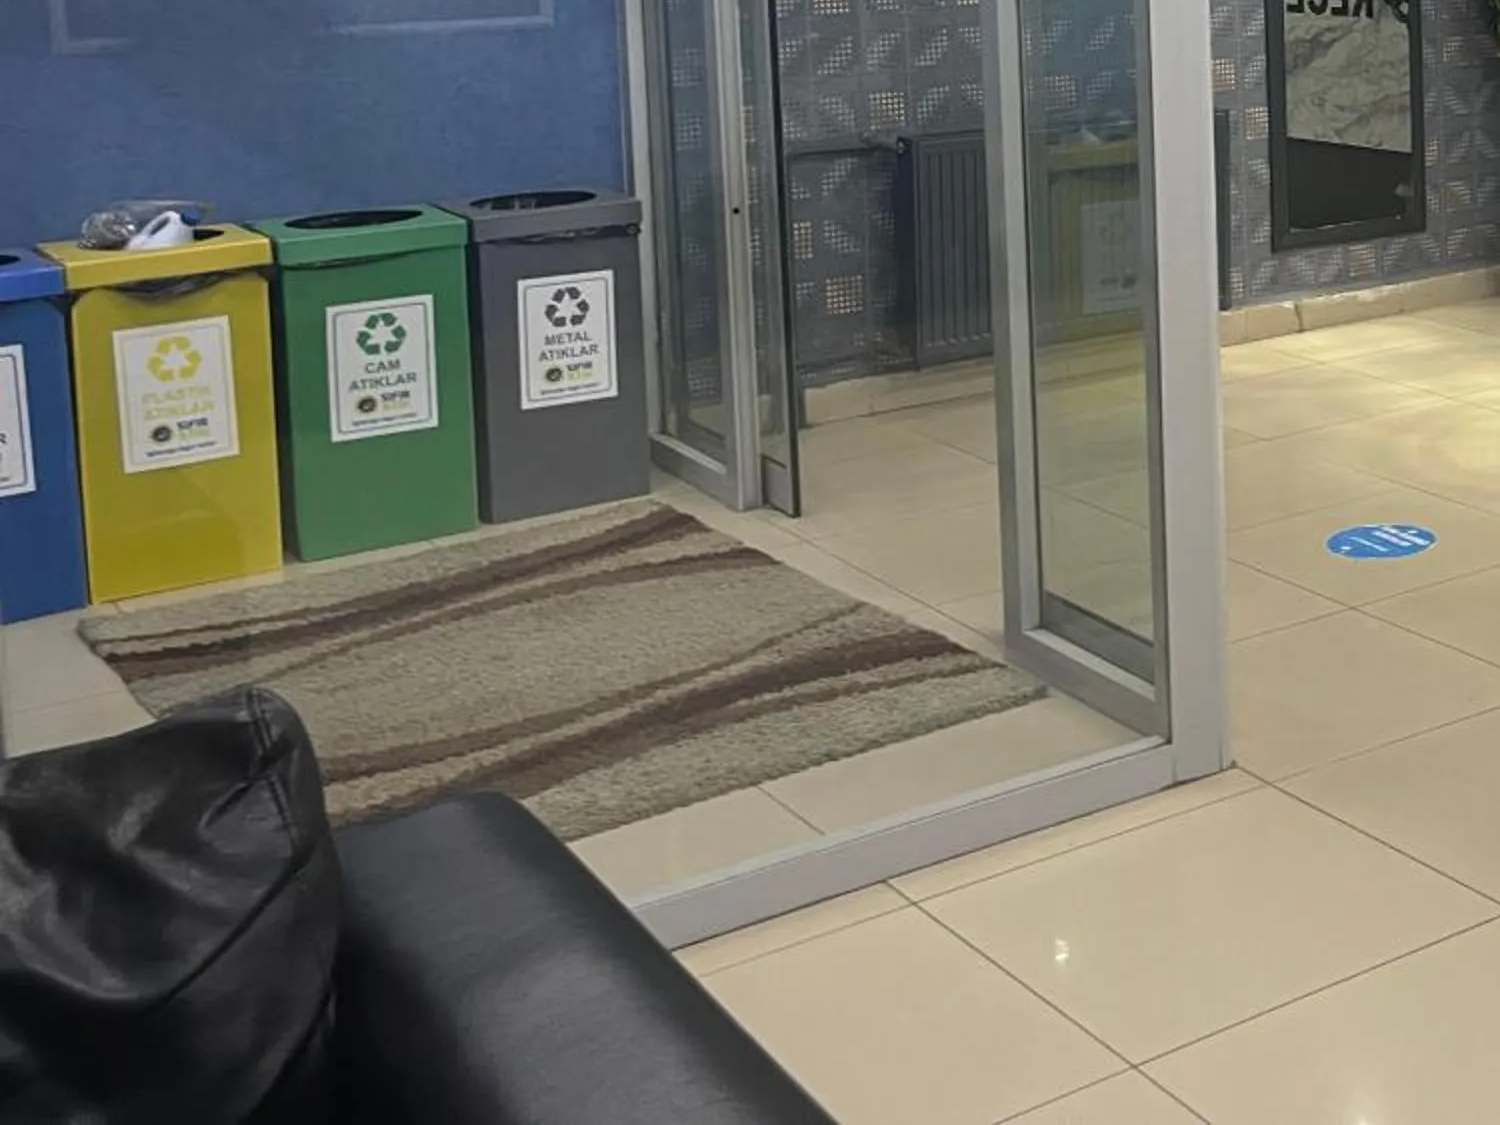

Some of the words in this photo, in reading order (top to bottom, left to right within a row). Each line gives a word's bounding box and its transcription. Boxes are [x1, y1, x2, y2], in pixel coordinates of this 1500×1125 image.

[544, 331, 593, 345] METAL
[538, 344, 600, 362] ATIKLAR
[364, 359, 400, 374] CAM
[349, 372, 417, 391] ATIKLAR
